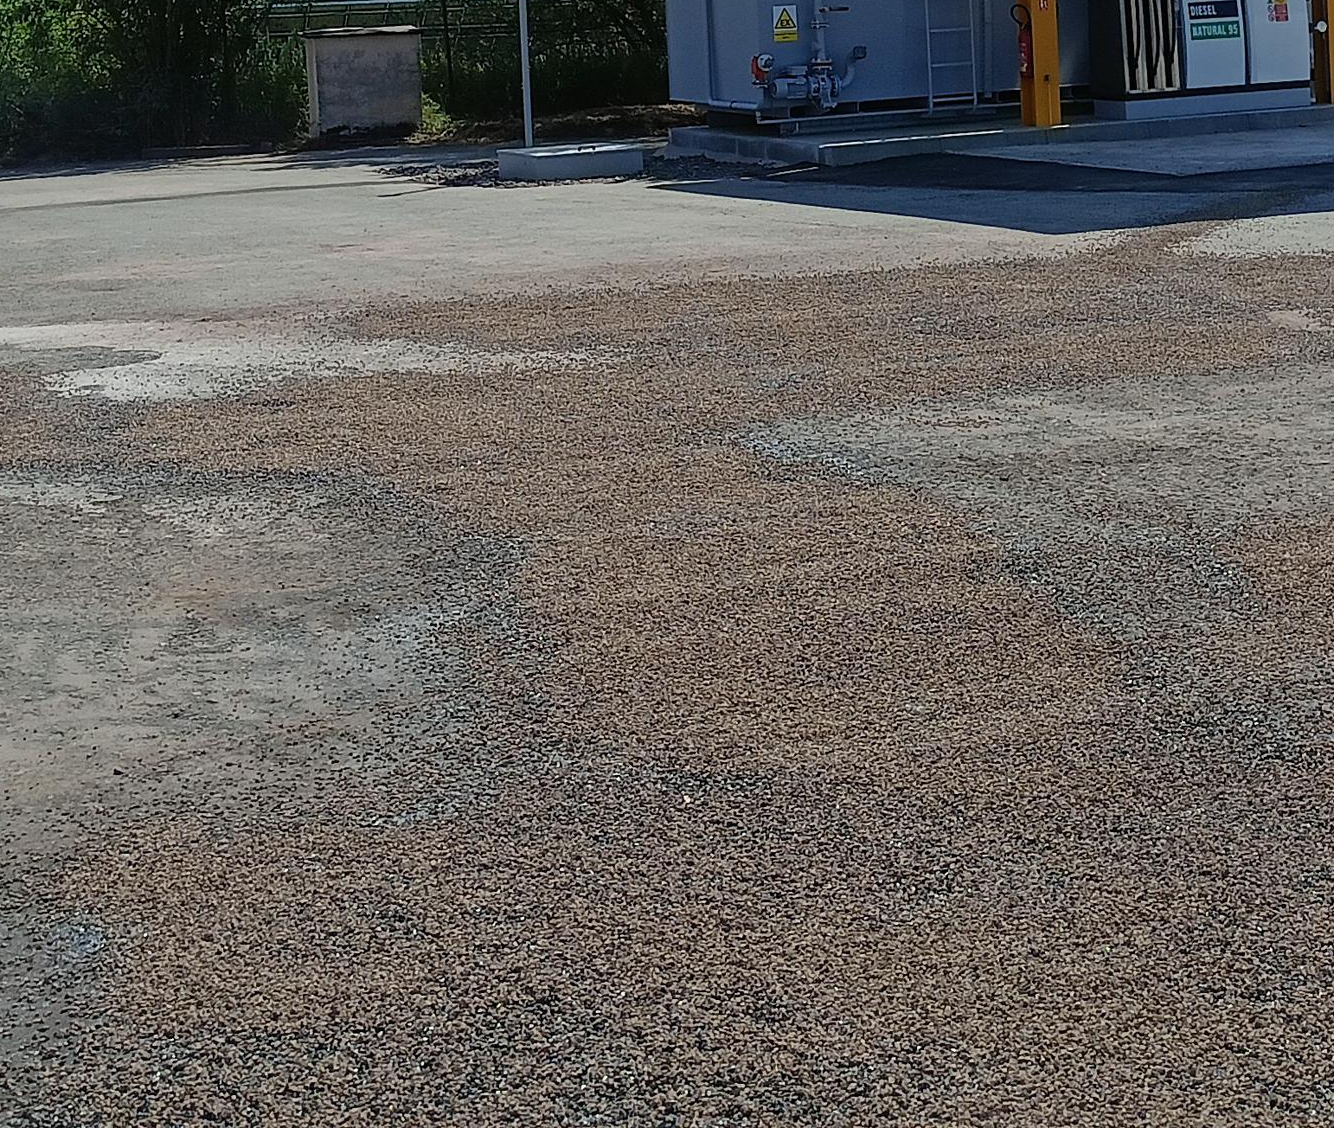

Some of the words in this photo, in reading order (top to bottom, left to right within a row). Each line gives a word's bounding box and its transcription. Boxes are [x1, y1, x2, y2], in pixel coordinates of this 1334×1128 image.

[1190, 5, 1217, 16] DIESEL
[1192, 25, 1226, 37] NATURAL
[1229, 24, 1238, 34] 95
